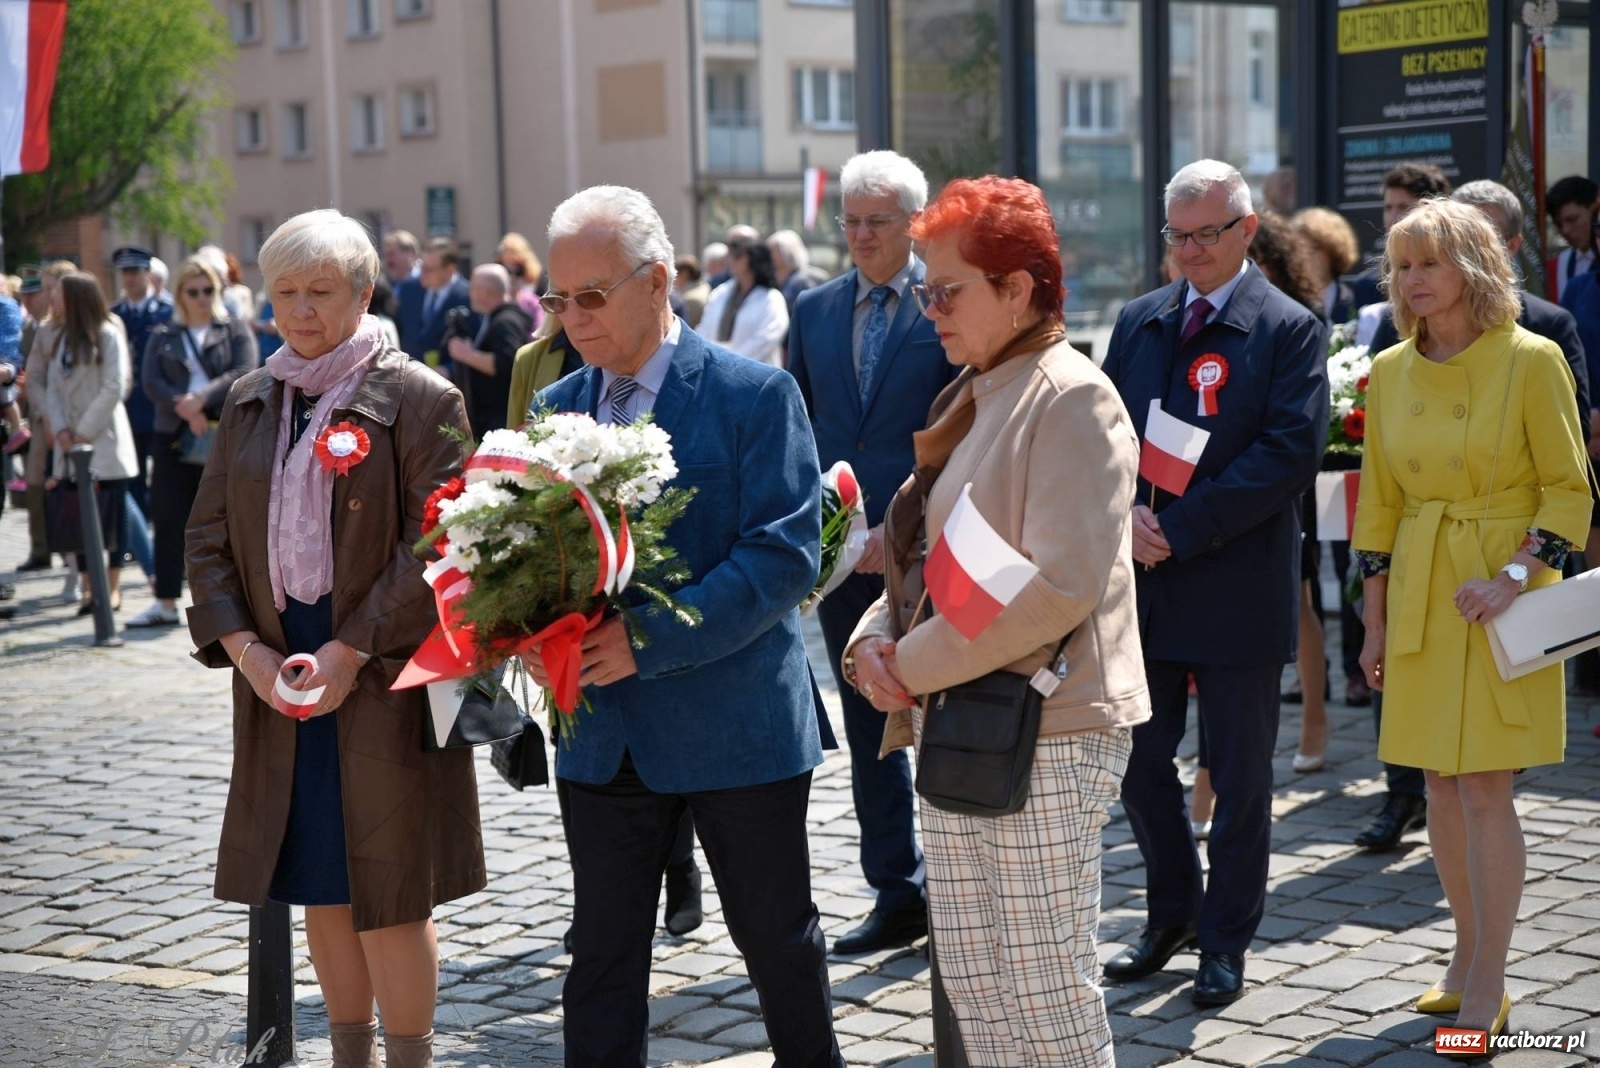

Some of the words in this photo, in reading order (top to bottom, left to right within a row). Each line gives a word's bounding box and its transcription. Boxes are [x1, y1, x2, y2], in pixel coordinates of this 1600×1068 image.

[1342, 10, 1400, 47] CATERING
[1403, 1, 1487, 40] DIETETYCZNY
[1402, 52, 1426, 76] BEZ
[1428, 46, 1487, 73] PSZENICY
